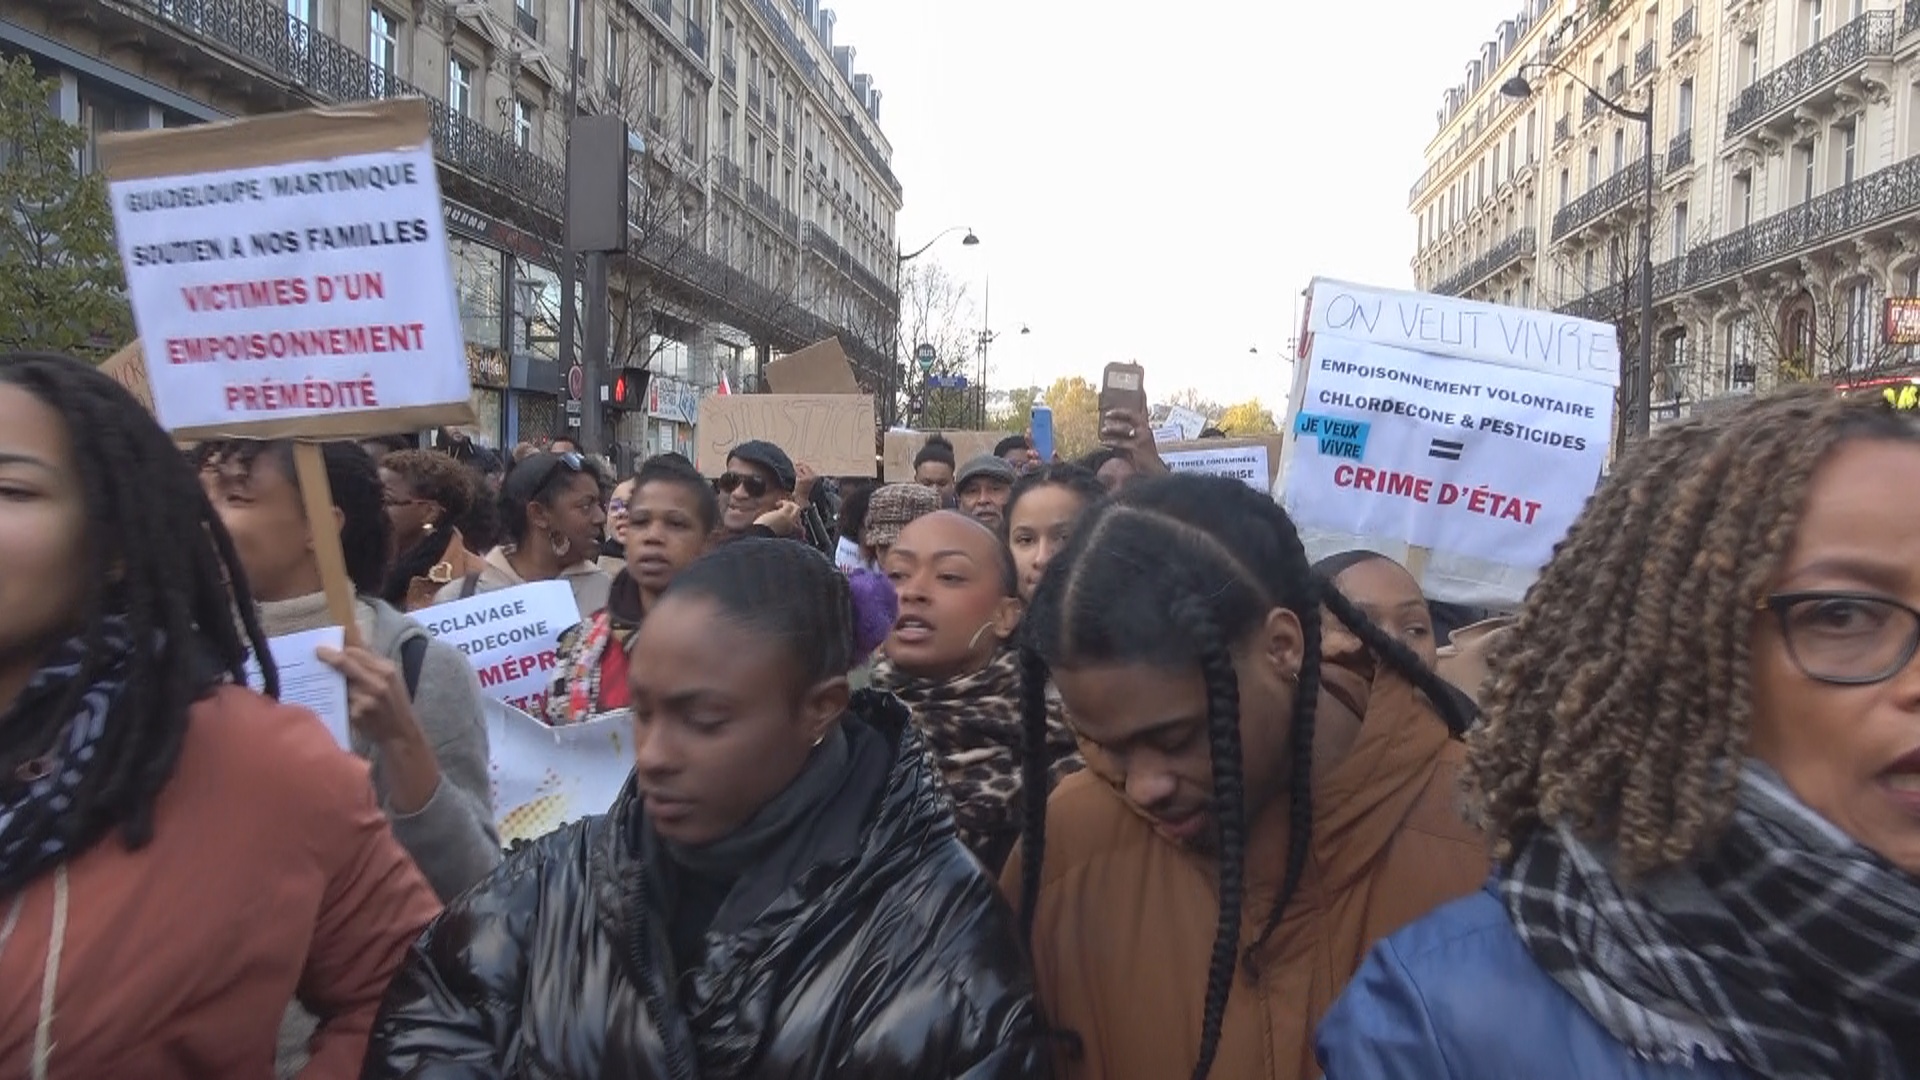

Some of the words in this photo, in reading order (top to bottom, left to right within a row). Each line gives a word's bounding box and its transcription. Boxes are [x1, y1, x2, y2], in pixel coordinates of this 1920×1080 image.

[271, 163, 418, 198] MARTINIQUE
[132, 238, 222, 266] SOUTIEN
[228, 236, 243, 259] A
[251, 229, 298, 258] NOS
[305, 219, 428, 252] FAMILLES
[180, 277, 308, 313] VICTIMES
[316, 272, 386, 303] D'UN
[166, 323, 426, 364] EMPOISONNEMENT
[1325, 294, 1382, 333] ON
[1398, 302, 1488, 349] VEUT
[1497, 312, 1616, 373] VIVRE
[224, 372, 379, 411] PRÉMÉDITÉ
[1320, 358, 1483, 398] EMPOISONNEMENT
[1486, 386, 1595, 419] VOLONTAIRE
[1301, 417, 1319, 435] JE
[1322, 418, 1360, 439] VEUX
[1479, 416, 1587, 452] PESTICIDES
[1333, 464, 1433, 503] CRIME
[1437, 484, 1542, 525] D'ÉTAT
[427, 599, 527, 637] SCLAVAGE
[457, 620, 549, 655] RDECONE
[477, 649, 557, 689] MÉPR
